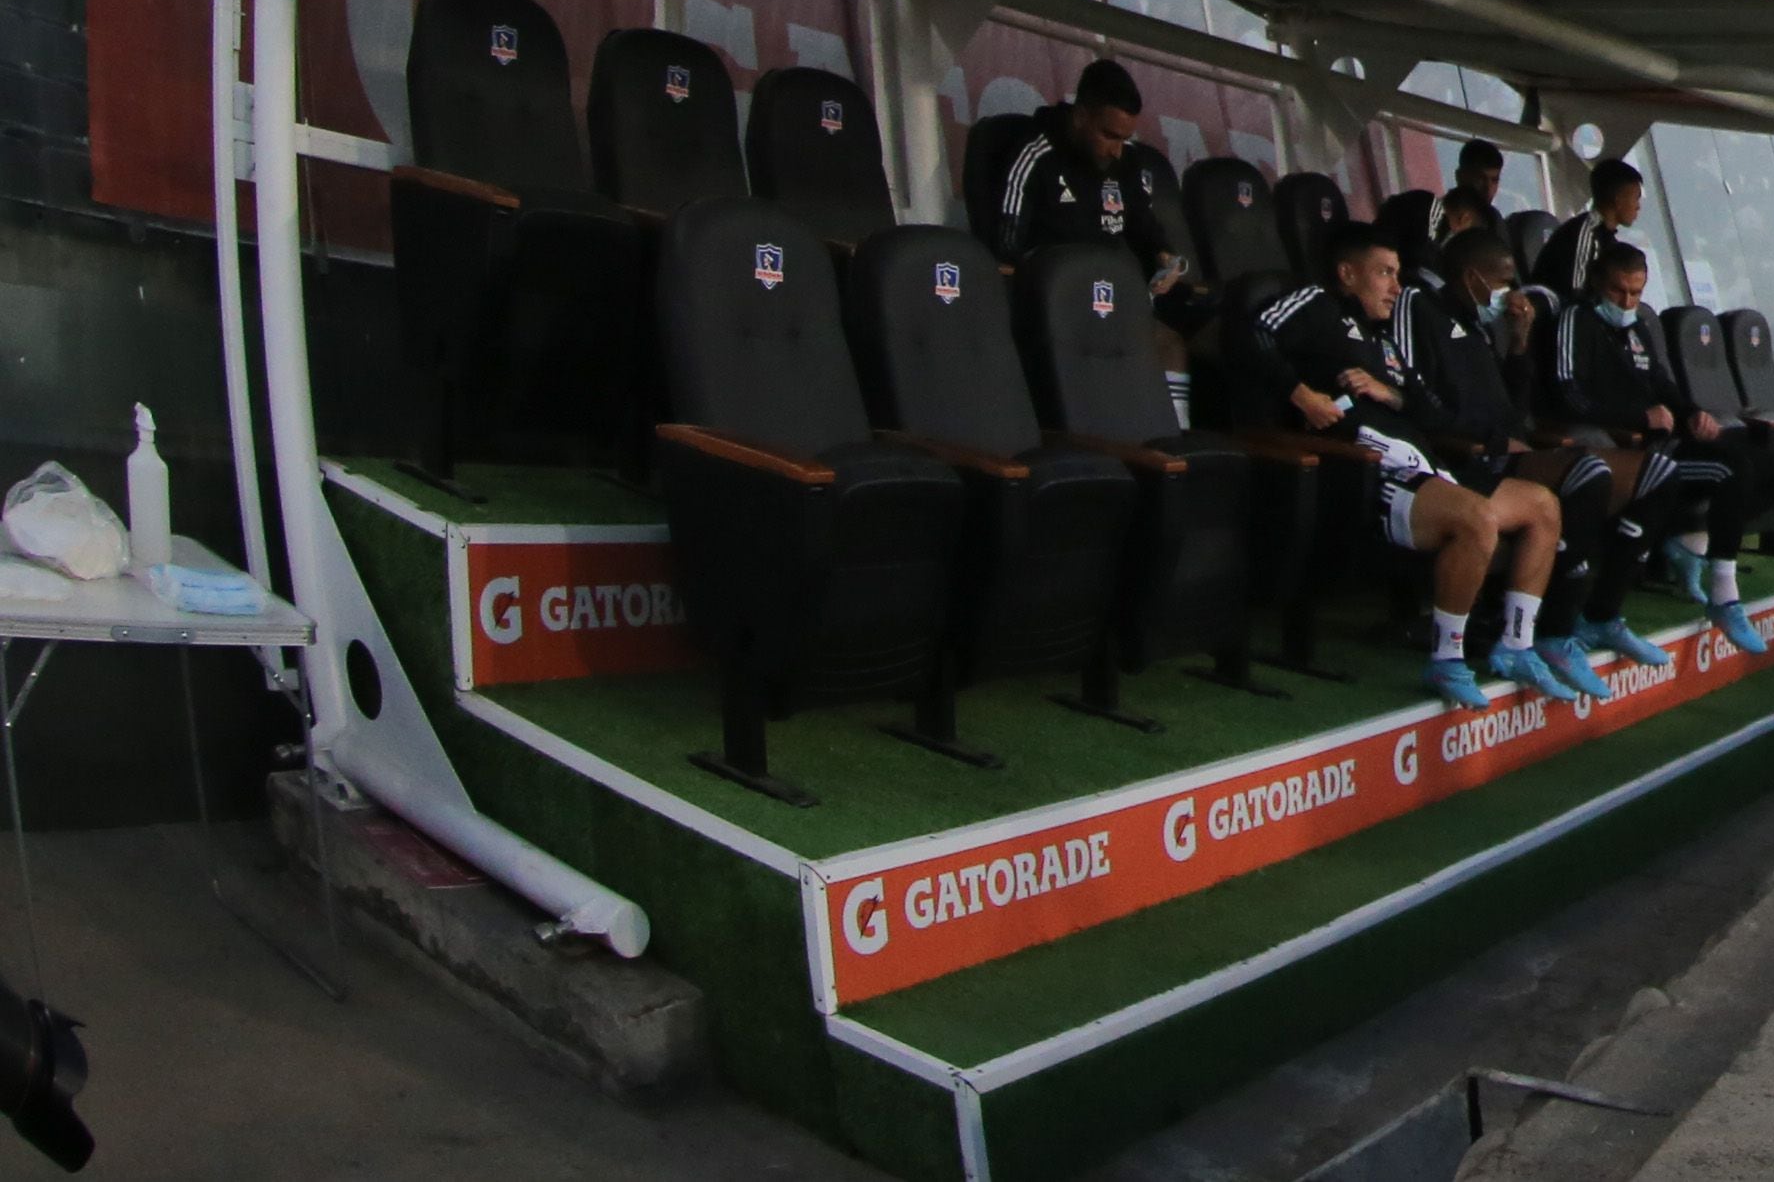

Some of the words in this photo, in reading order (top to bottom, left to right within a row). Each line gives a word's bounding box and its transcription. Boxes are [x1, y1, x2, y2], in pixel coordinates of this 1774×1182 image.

[480, 575, 523, 645] G
[842, 877, 888, 956] G
[904, 830, 1111, 929] GATORADE
[1163, 796, 1197, 862] G
[1208, 758, 1356, 841] GATORADE
[1394, 730, 1418, 785] G
[1441, 696, 1547, 763] GATORADE
